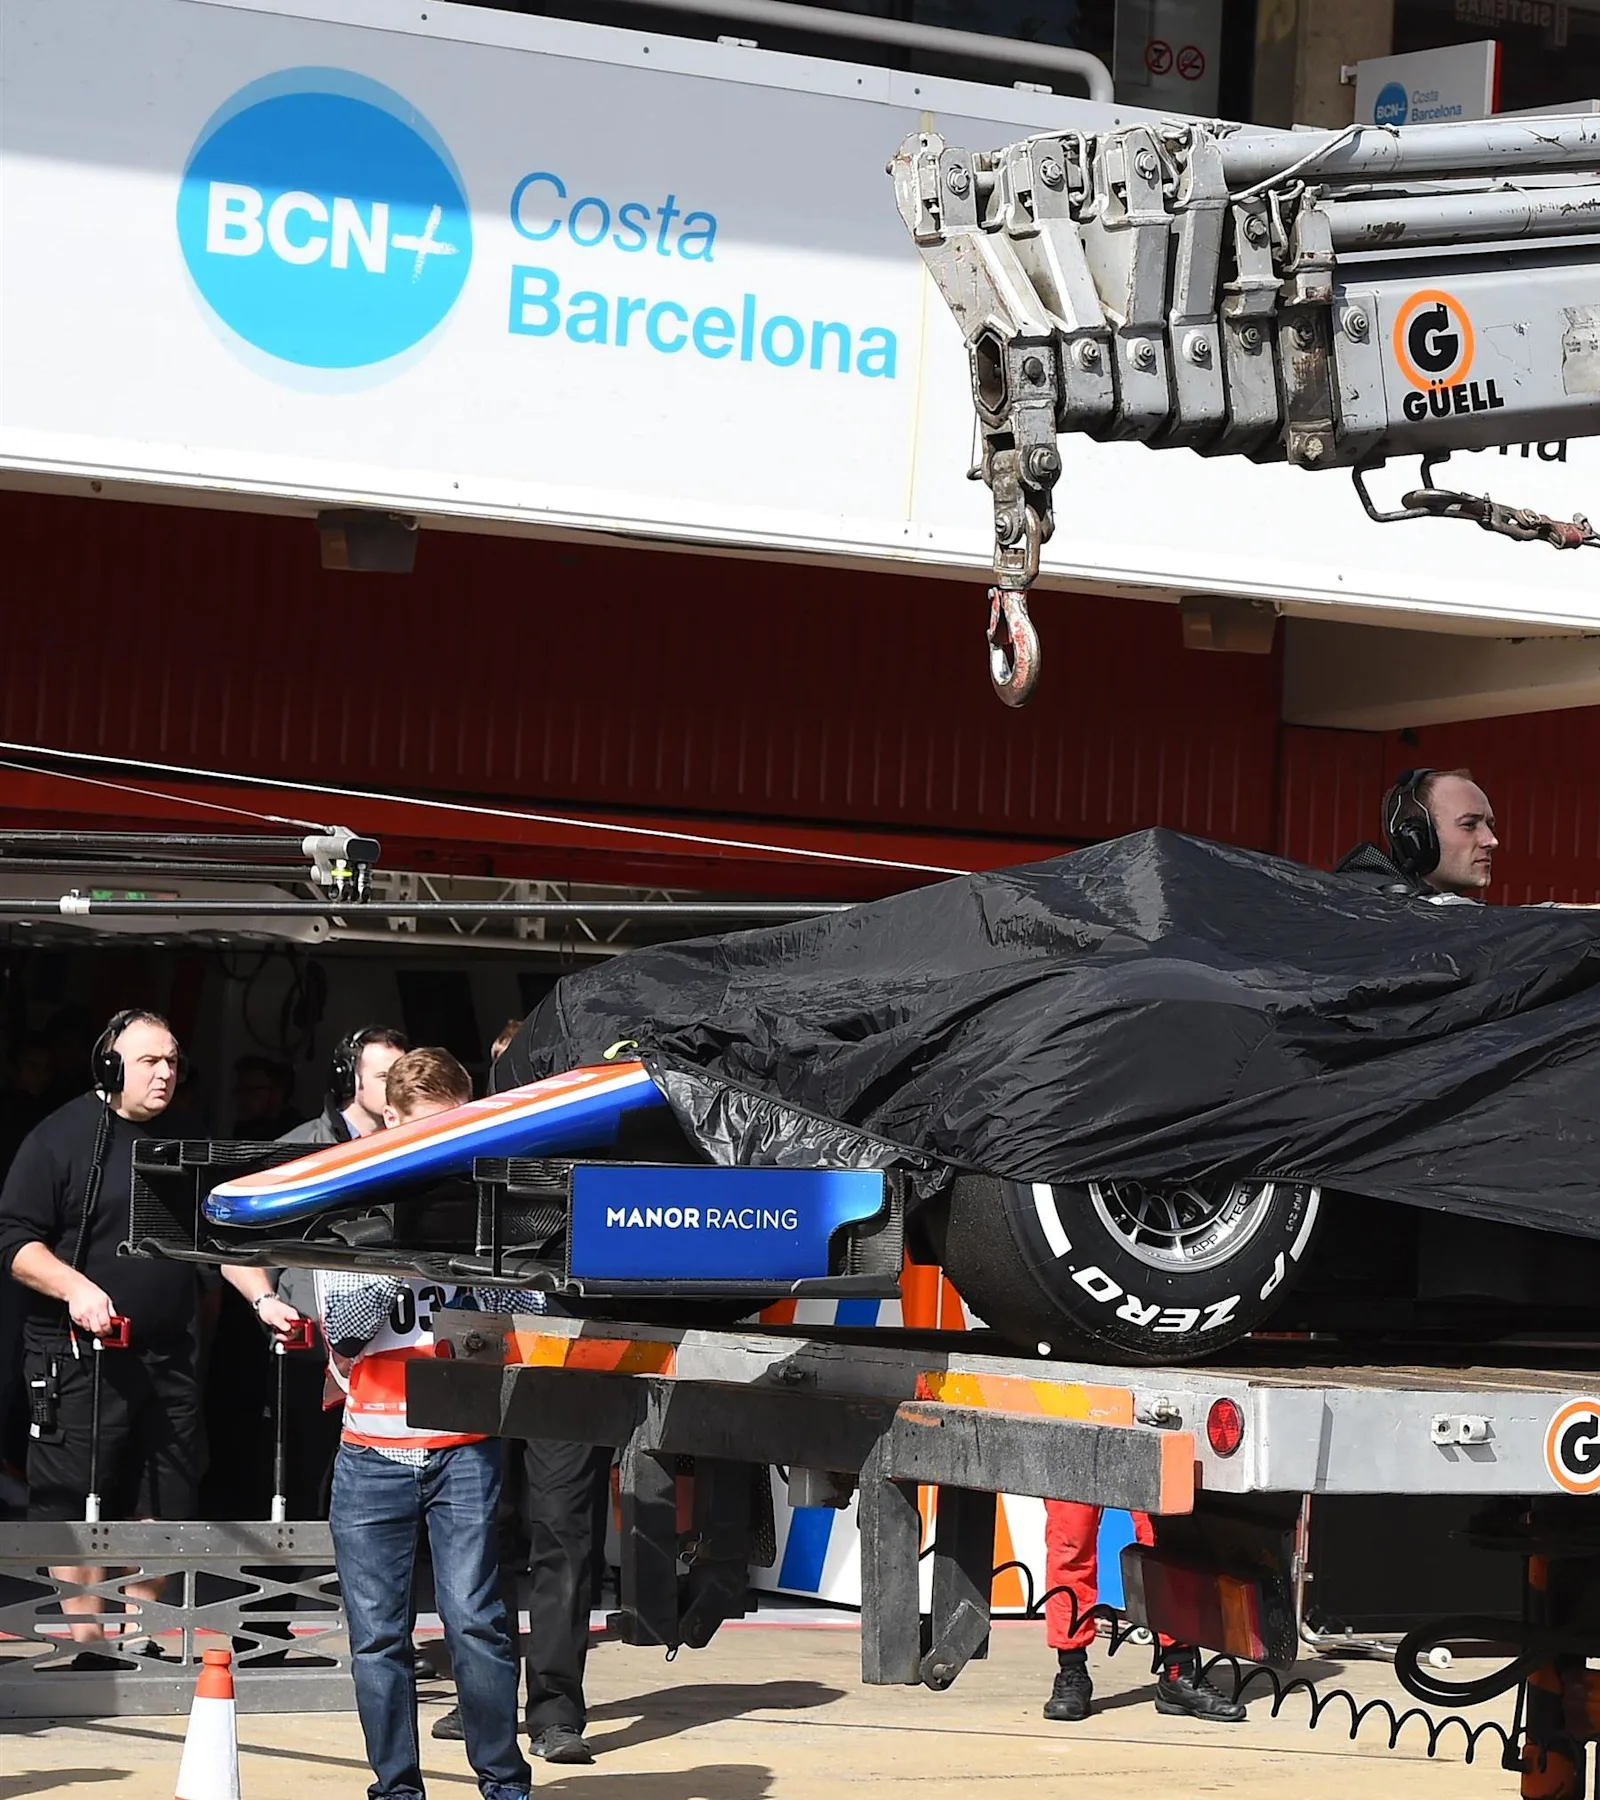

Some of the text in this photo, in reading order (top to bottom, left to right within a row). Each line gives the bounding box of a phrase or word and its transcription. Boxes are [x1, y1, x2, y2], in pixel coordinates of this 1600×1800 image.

[1411, 90, 1439, 105] Costa
[1411, 103, 1463, 123] Barcelona
[508, 171, 719, 263] Costa
[507, 264, 898, 379] Barcelona
[1402, 378, 1505, 422] GÜELL
[606, 1206, 798, 1230] MANOR RACING
[1192, 1183, 1252, 1255] APP TECH
[1071, 1250, 1285, 1333] P ZERO
